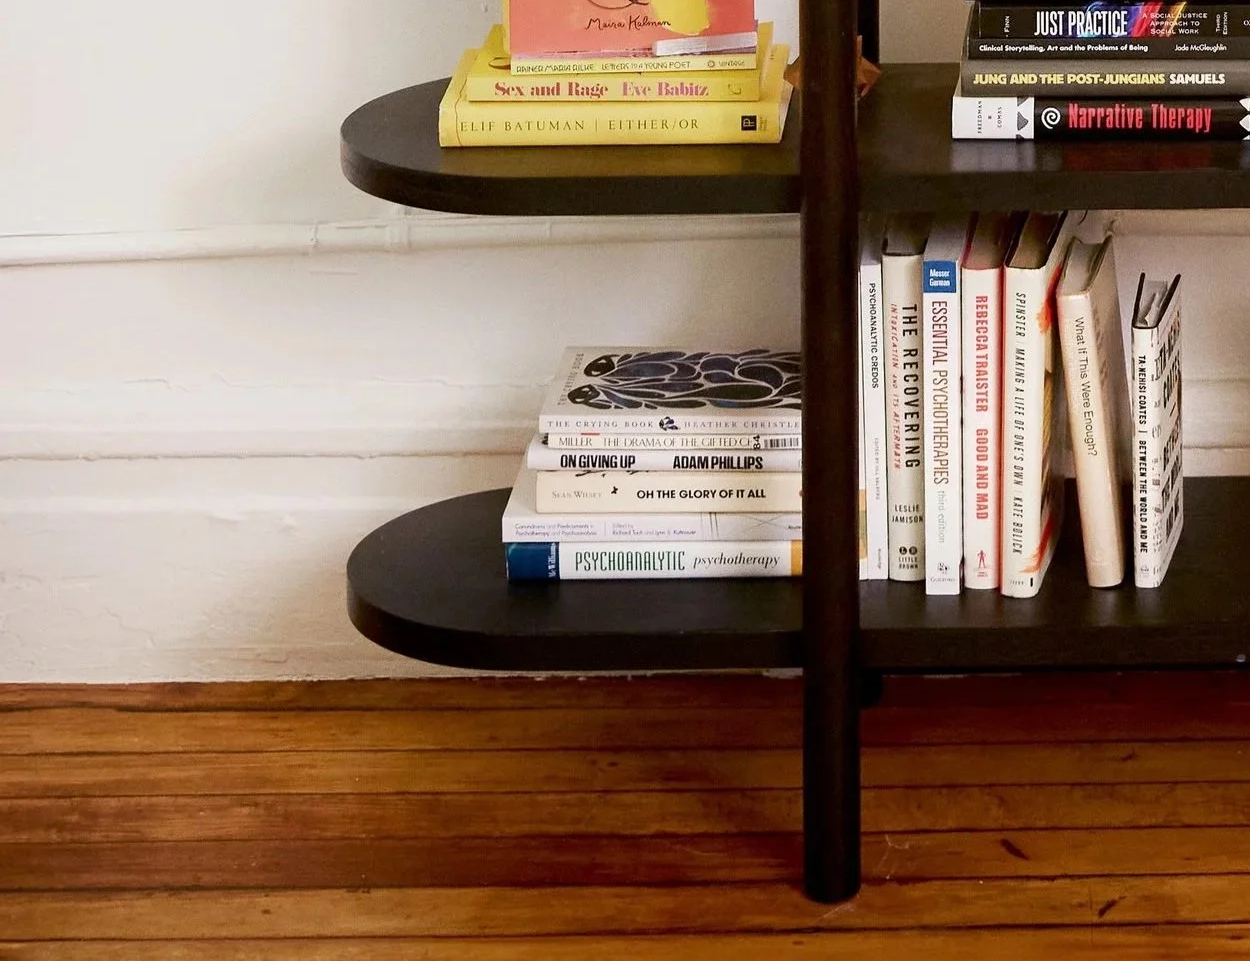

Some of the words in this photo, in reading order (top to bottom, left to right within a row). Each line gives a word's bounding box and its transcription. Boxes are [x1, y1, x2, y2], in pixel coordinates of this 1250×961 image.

[1034, 11, 1064, 36] JUST
[1068, 11, 1128, 36] PRACTICE
[494, 81, 524, 96] Sex
[530, 81, 560, 96] and
[568, 81, 608, 99] Rage
[622, 82, 651, 96] Eve
[657, 82, 709, 96] Babitz
[973, 74, 1006, 84] JUNG
[1010, 74, 1037, 84] AND
[1039, 74, 1064, 84] THE
[1067, 74, 1165, 85] POST-JUNGIANS
[1170, 74, 1225, 84] SAMUELS
[460, 121, 496, 131] ELIF
[504, 120, 584, 131] BATUMAN
[609, 119, 699, 130] EITHER/OR
[1068, 103, 1143, 128] Narrative
[1152, 104, 1212, 133] Therapy
[902, 304, 917, 337] THE
[976, 296, 988, 351] REBECCA
[932, 301, 947, 365] ESSENTIAL
[976, 354, 988, 412] TRAISTER
[902, 348, 920, 468] RECOVERING
[933, 370, 948, 485] PSYCHOTHERAPIES
[976, 429, 988, 461] GOOD
[560, 454, 576, 468] ON
[579, 455, 618, 468] GIVING
[619, 455, 635, 468] UP
[673, 456, 708, 469] ADAM
[711, 456, 763, 469] PHILLIPS
[976, 465, 988, 489] AND
[637, 490, 653, 498] OH
[657, 490, 675, 498] THE
[679, 490, 716, 498] GLORY
[719, 490, 733, 498] OF
[736, 490, 744, 498] IT
[747, 489, 766, 498] ALL
[976, 493, 988, 519] MAD
[575, 551, 685, 571] PSYCHOANALYTIC
[693, 553, 780, 569] psychotherapy
